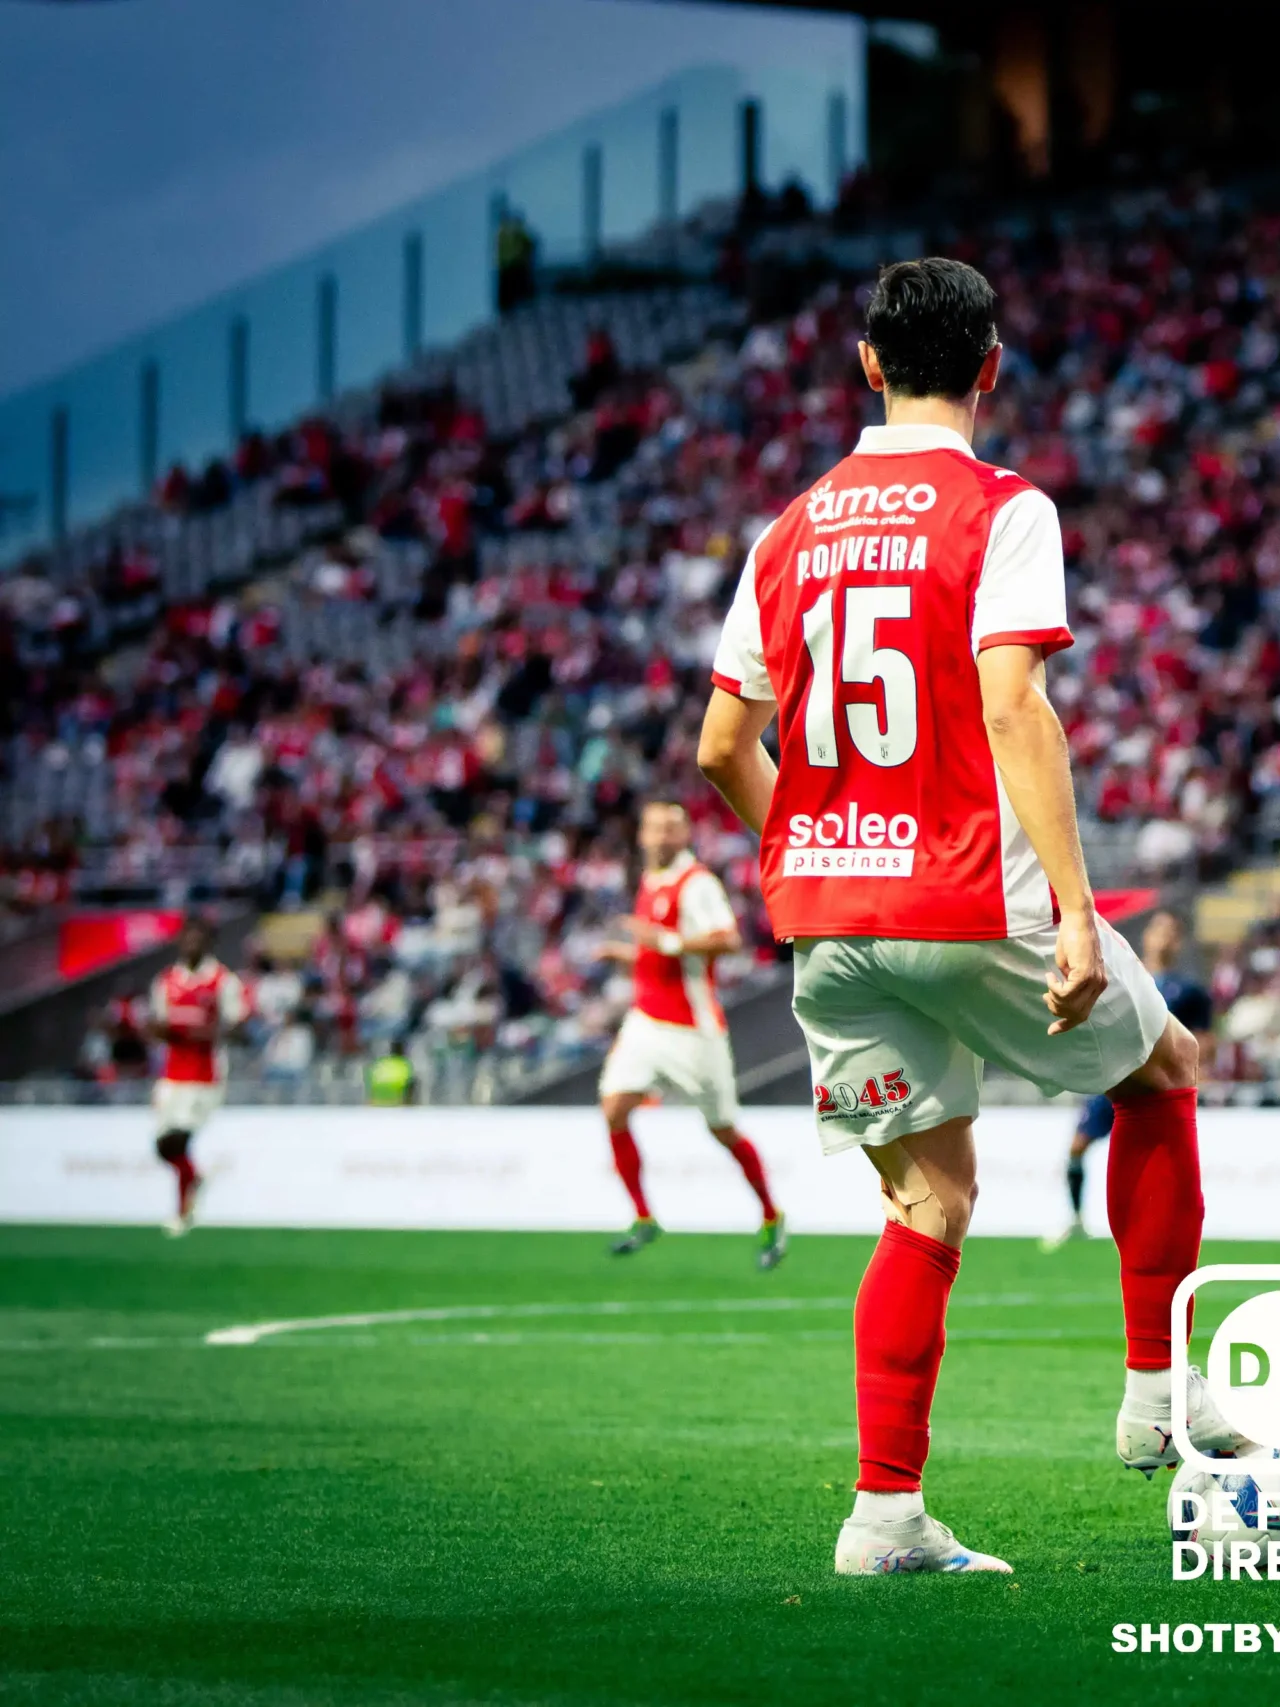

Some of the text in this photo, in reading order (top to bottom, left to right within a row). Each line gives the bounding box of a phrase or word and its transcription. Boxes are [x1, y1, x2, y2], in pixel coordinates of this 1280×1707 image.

[806, 480, 937, 523] amco
[802, 585, 918, 768] 15
[788, 802, 918, 847] soleo
[794, 851, 901, 872] piscinas
[815, 1067, 911, 1116] 2045
